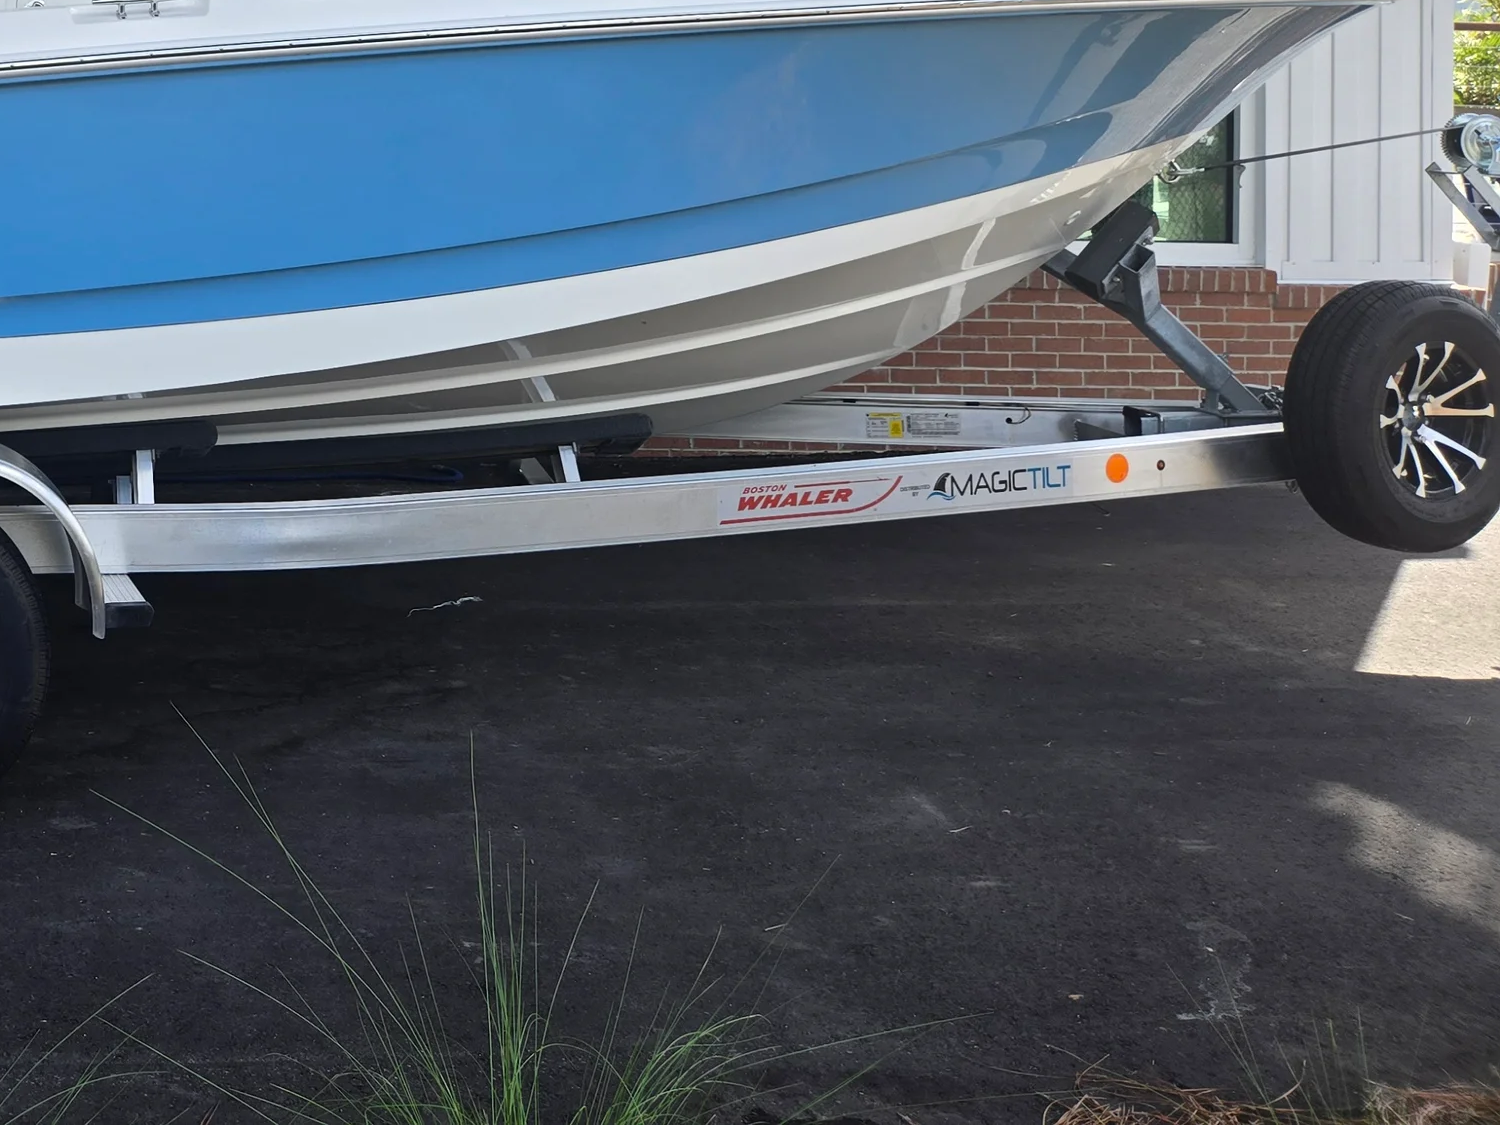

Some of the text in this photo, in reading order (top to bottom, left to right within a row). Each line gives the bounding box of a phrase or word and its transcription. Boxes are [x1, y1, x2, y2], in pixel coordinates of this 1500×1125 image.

[742, 484, 788, 495] BOSTON
[950, 465, 1071, 496] MAGICTILT
[737, 488, 853, 512] WHALER
